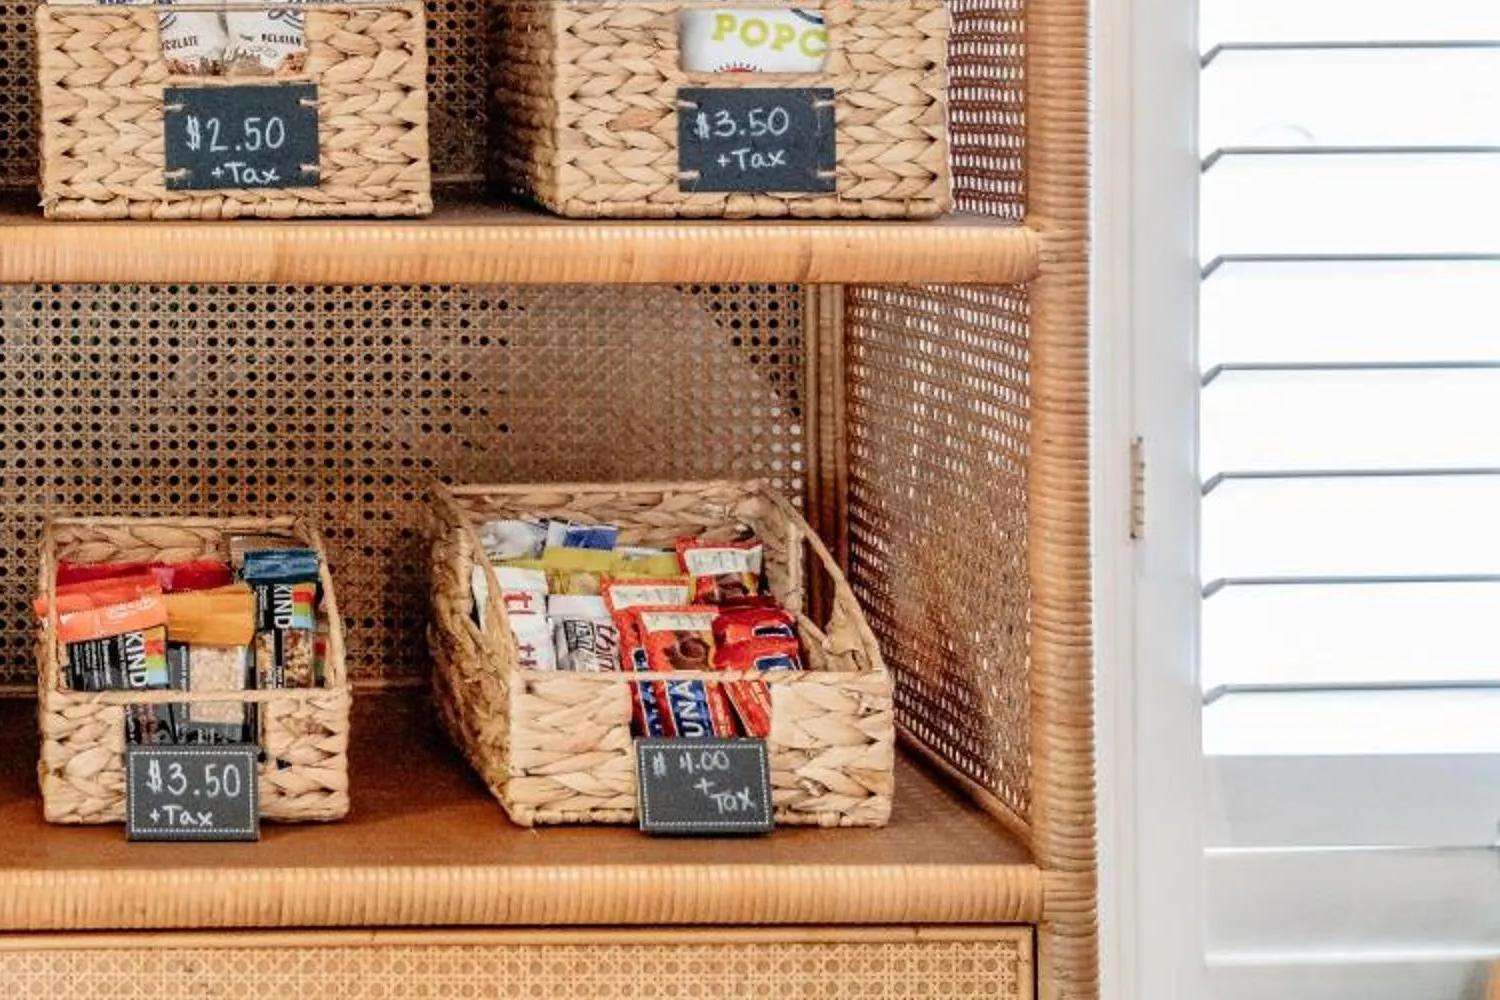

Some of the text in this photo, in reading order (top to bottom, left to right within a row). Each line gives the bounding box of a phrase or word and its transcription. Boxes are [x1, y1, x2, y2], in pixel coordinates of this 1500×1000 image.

[186, 115, 285, 152] $2.50
[694, 106, 789, 139] $3.50
[274, 584, 292, 629] KIND
[125, 631, 148, 688] KIND
[146, 759, 241, 799] $3.50
